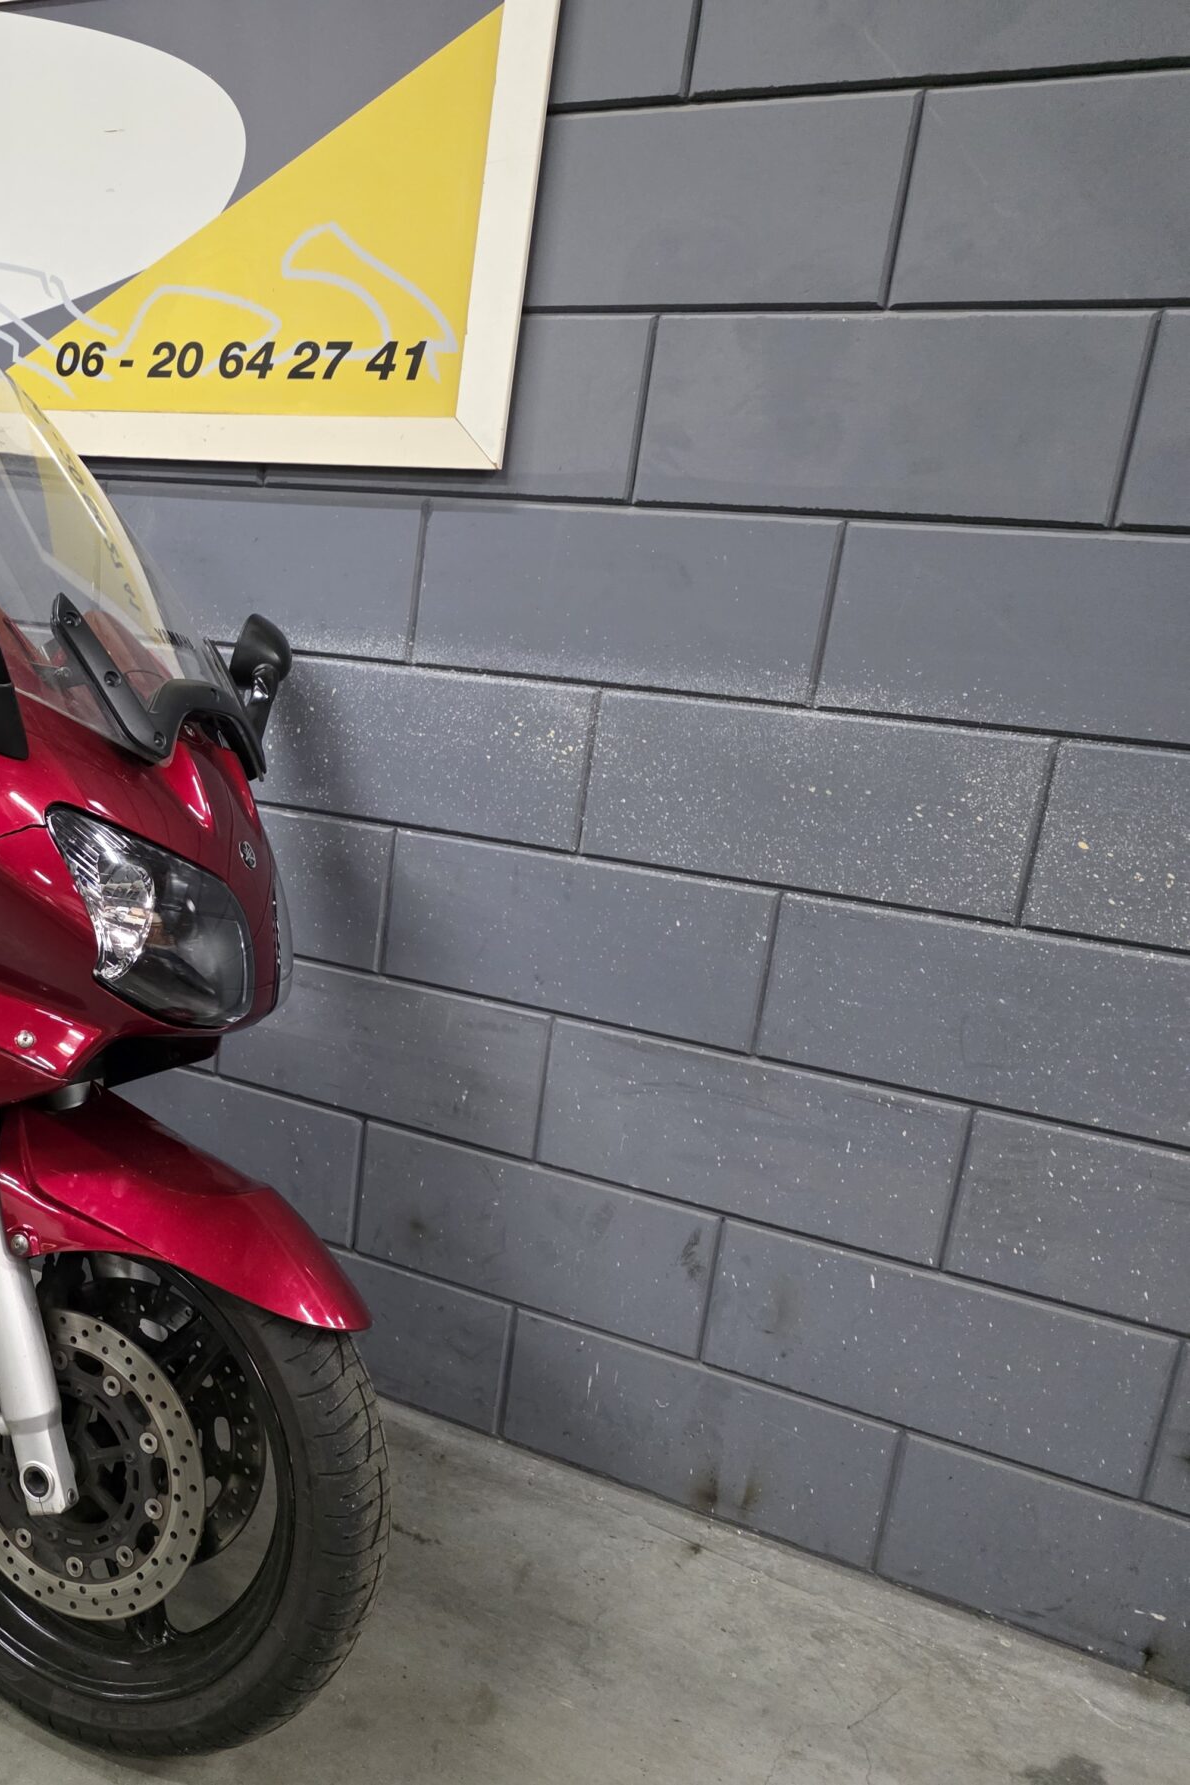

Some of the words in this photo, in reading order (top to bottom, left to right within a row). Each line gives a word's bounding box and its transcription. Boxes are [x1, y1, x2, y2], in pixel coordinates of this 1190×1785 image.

[55, 341, 105, 378] 06
[119, 360, 134, 368] -
[147, 341, 204, 378] 20
[218, 341, 276, 379] 64
[287, 341, 353, 380] 27
[365, 341, 428, 380] 41
